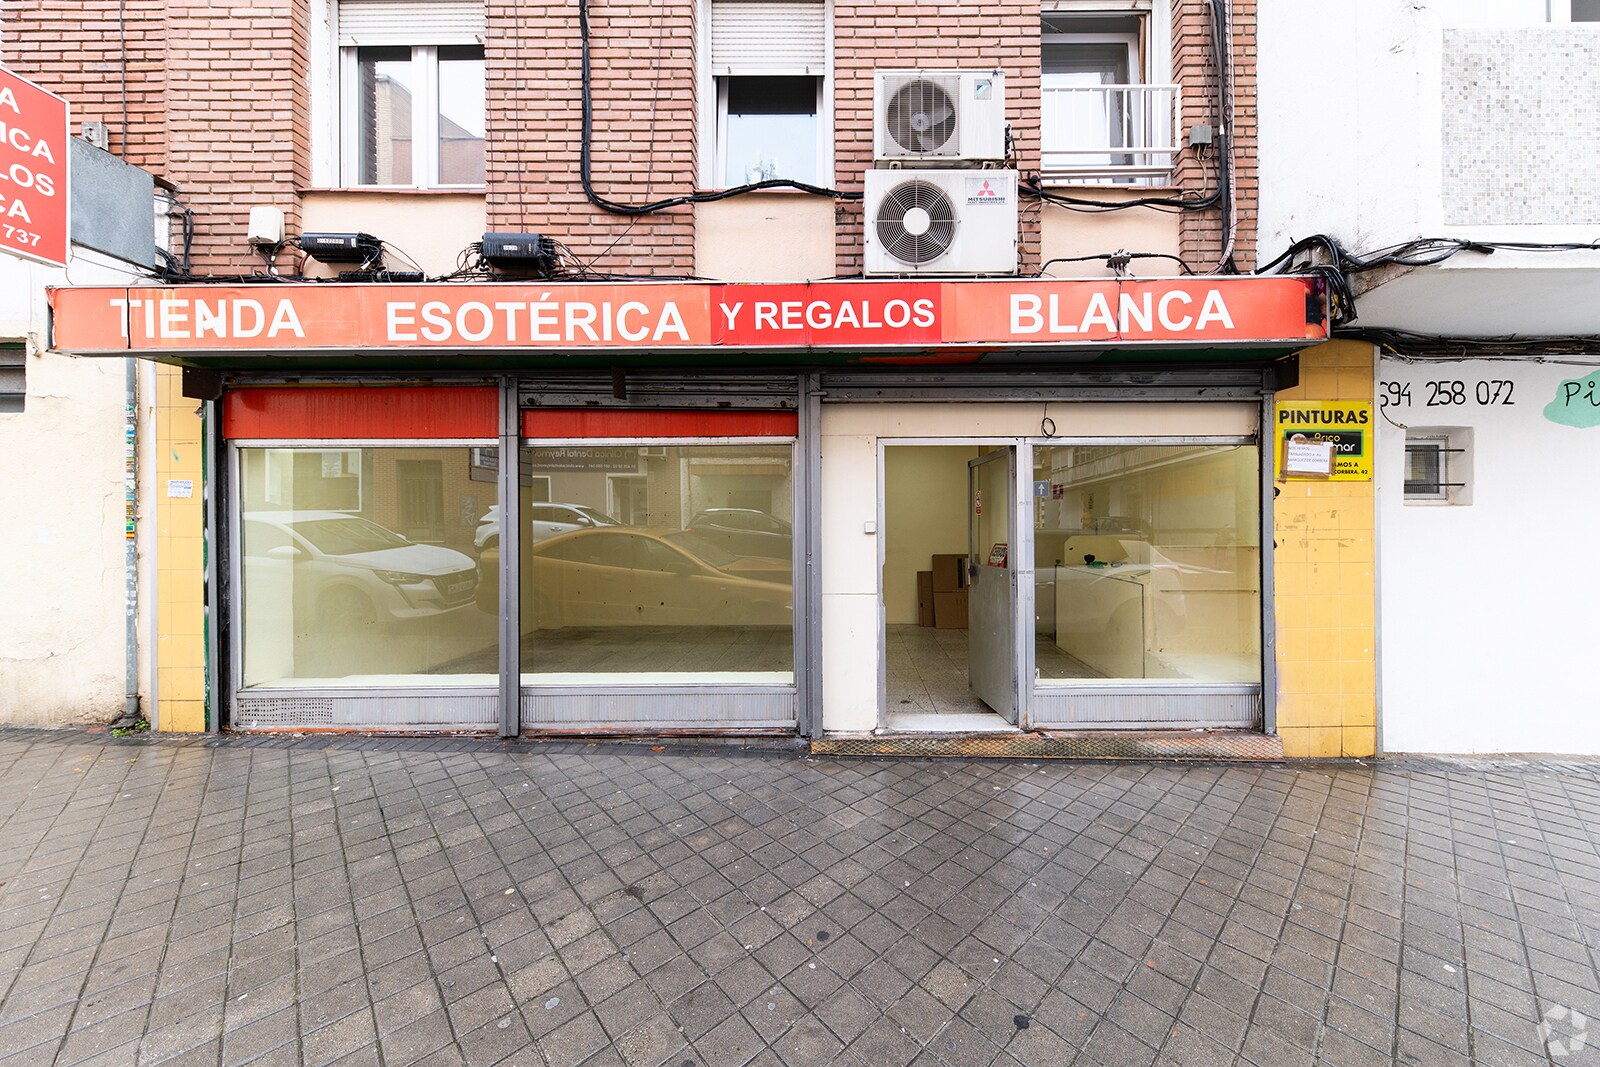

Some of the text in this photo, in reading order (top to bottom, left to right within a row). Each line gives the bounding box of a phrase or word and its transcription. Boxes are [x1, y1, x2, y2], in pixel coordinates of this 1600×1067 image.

[2, 223, 42, 248] 737
[109, 289, 1236, 343] TIENDA ESOTÉRICA Y REGALOS BLANCA
[1425, 380, 1466, 407] 258
[1475, 380, 1515, 406] 072
[1279, 409, 1369, 425] PINTURAS
